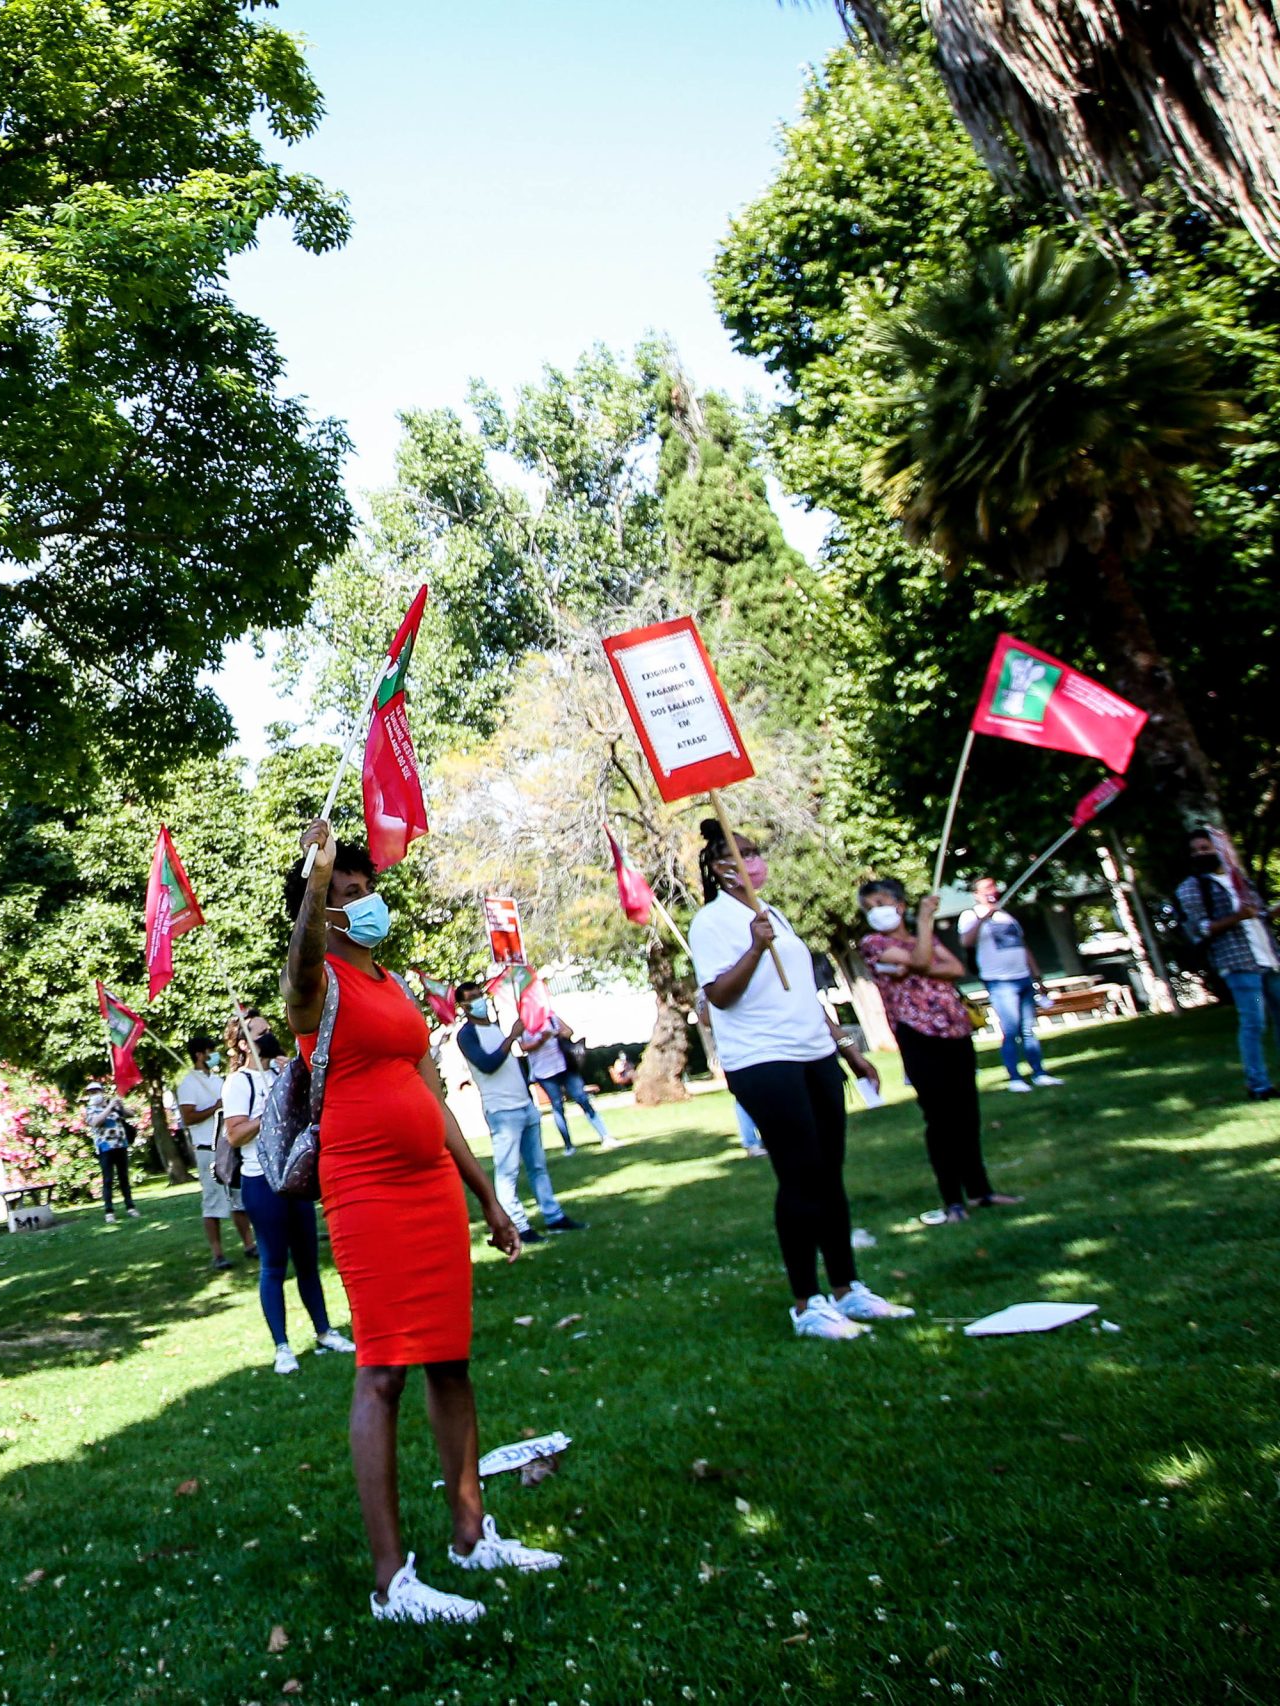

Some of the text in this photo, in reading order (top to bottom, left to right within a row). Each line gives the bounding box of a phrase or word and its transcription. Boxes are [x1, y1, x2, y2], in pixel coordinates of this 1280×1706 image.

[641, 662, 686, 681] EXIGIMOS O
[646, 679, 695, 699] PAGAMENTO
[650, 706, 666, 717] DOS
[678, 719, 690, 729] EM
[677, 734, 708, 749] ATRASO
